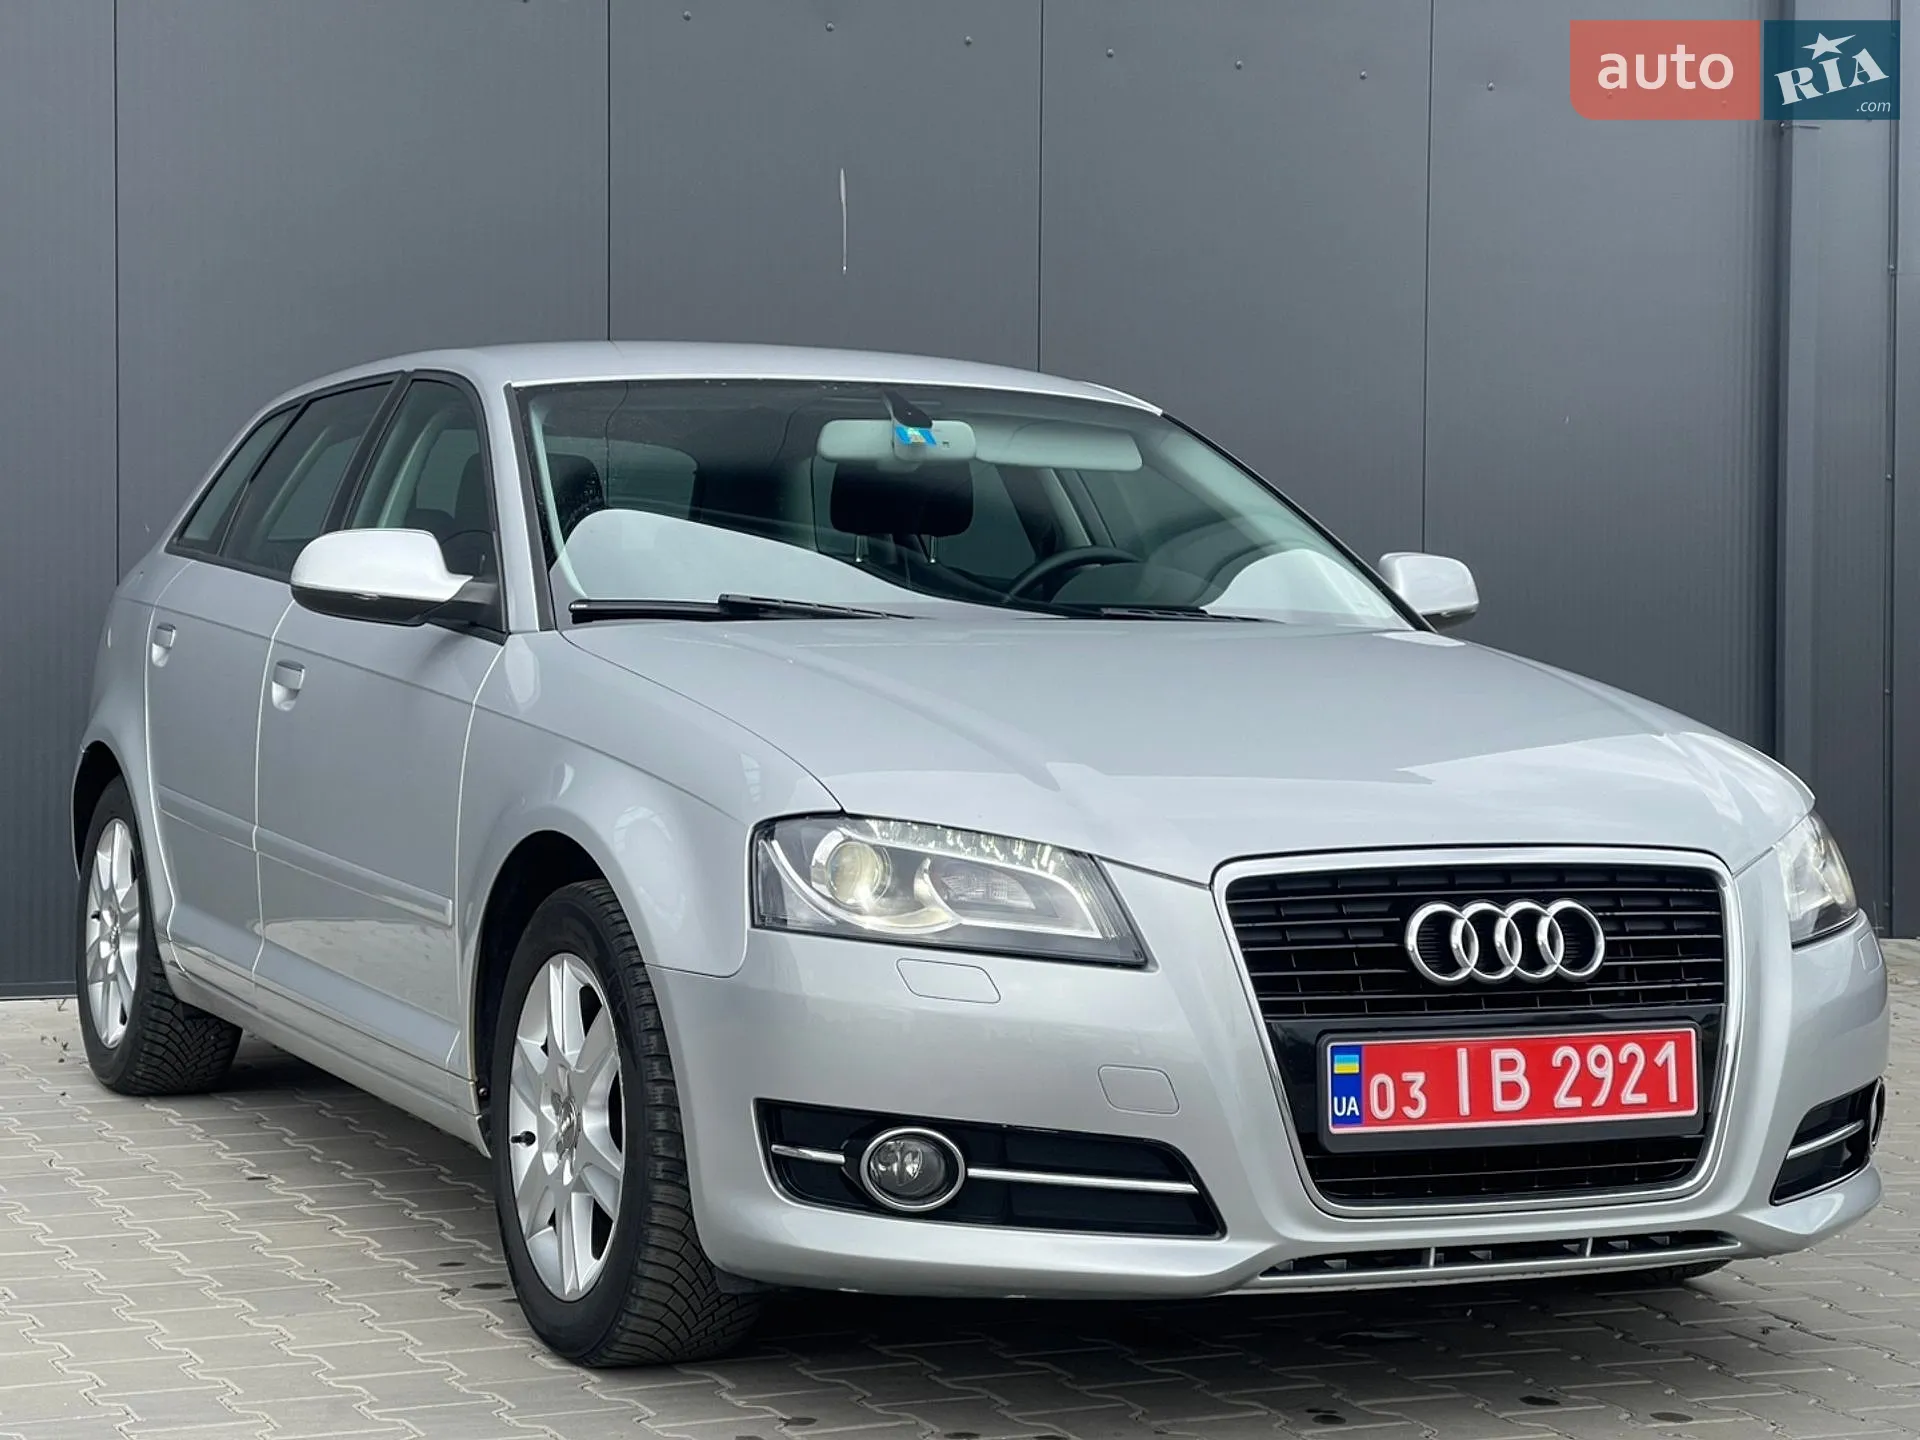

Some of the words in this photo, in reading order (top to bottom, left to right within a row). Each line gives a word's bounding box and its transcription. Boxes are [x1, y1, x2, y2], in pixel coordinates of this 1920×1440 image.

[1370, 1071, 1427, 1120] 03
[1457, 1046, 1531, 1116] IB
[1551, 1040, 1677, 1108] 2921
[1333, 1096, 1360, 1117] UA
